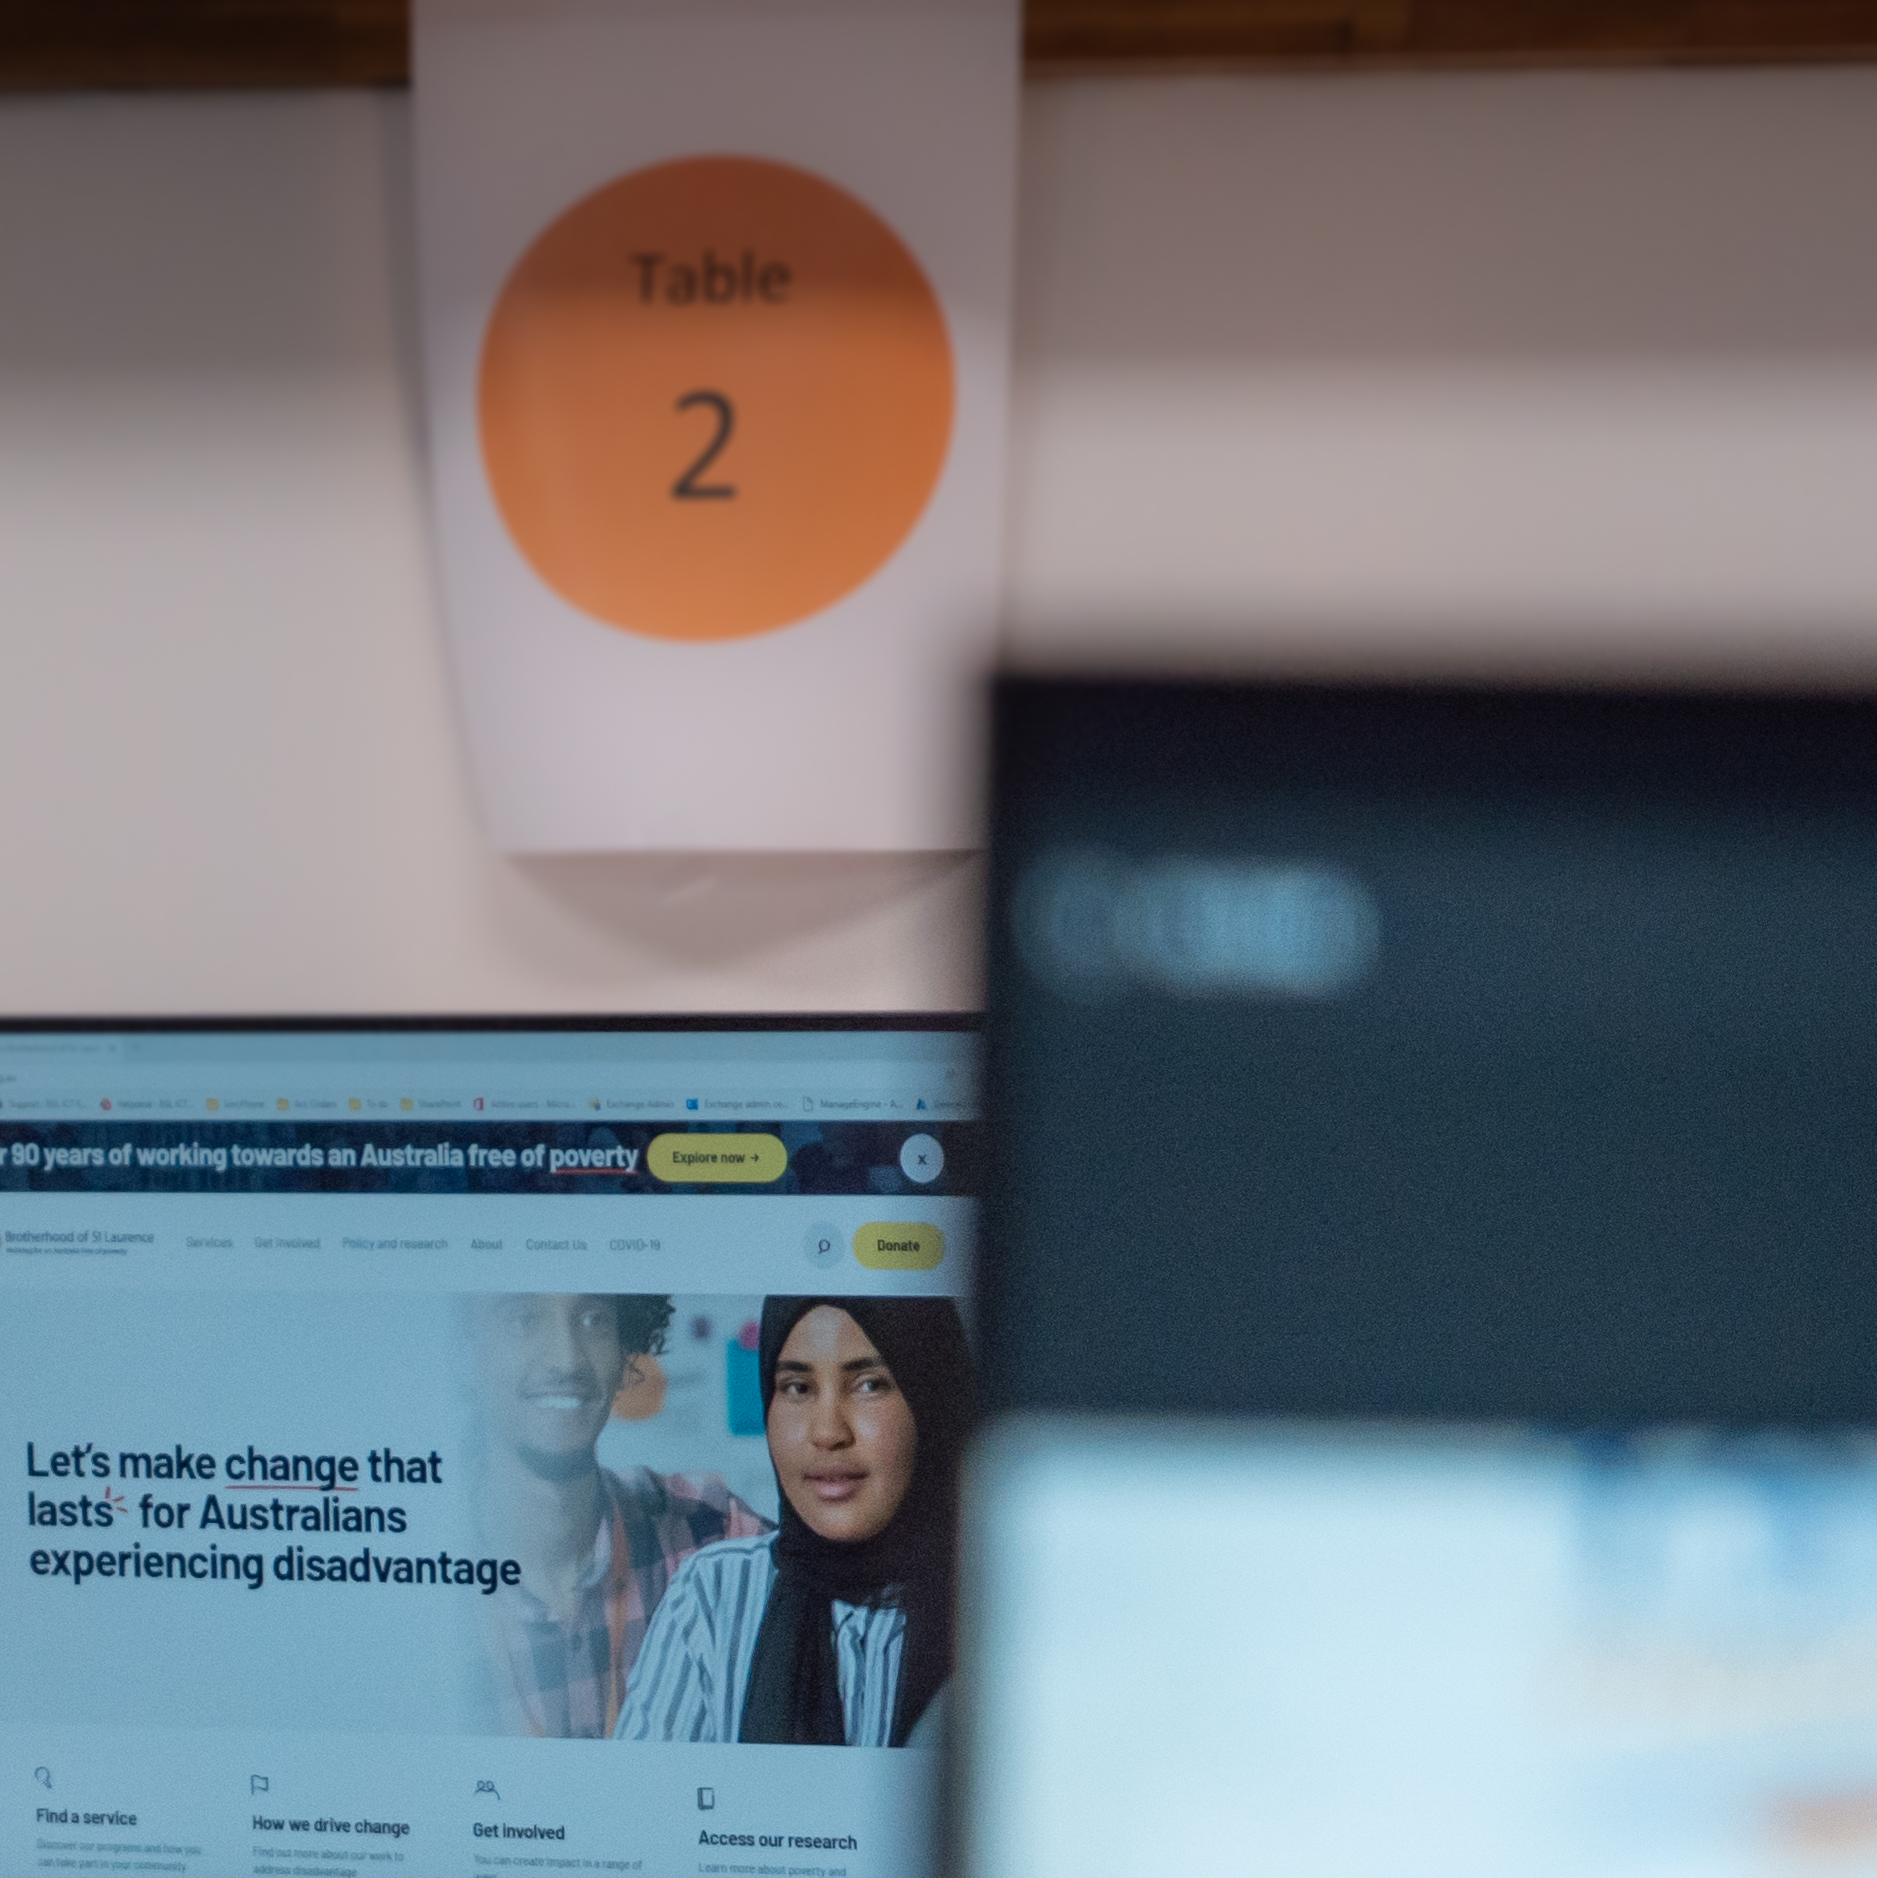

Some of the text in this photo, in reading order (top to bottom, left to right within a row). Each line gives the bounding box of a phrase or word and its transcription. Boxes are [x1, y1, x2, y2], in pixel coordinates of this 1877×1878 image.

[632, 250, 793, 306] Table
[670, 388, 738, 501] 2
[11, 1142, 39, 1167] 90
[43, 1144, 105, 1171] years
[109, 1143, 133, 1167] of
[137, 1142, 227, 1172] working
[231, 1143, 324, 1167] towards
[328, 1147, 356, 1167] an
[360, 1142, 464, 1168] Australia
[468, 1143, 516, 1167] free
[520, 1143, 546, 1167] of
[549, 1146, 639, 1173] poverty
[672, 1149, 746, 1167] Explore now
[5, 1231, 74, 1243] Brotherhood
[76, 1230, 89, 1242] of
[105, 1231, 154, 1243] Laurence
[186, 1236, 233, 1250] Services
[254, 1236, 274, 1250] Get
[342, 1236, 375, 1253] Policy
[376, 1237, 398, 1250] and
[400, 1237, 448, 1250] research
[471, 1237, 503, 1251] About
[525, 1237, 568, 1251] Contact
[609, 1238, 661, 1252] COVID-19
[877, 1238, 921, 1254] Donate
[120, 1446, 216, 1480] make
[226, 1446, 359, 1491] change
[368, 1448, 443, 1484] that
[28, 1491, 407, 1533] lasts for Australians
[30, 1543, 522, 1595] experiencing disadvantage
[36, 1808, 137, 1826] Find a service
[252, 1815, 411, 1839] How we drive change
[473, 1822, 565, 1841] Get involved
[698, 1829, 858, 1851] Access our research
[546, 1857, 581, 1870] impact
[603, 1861, 630, 1873] range
[632, 1858, 643, 1870] of
[699, 1862, 847, 1878] Learn more about poverty and
